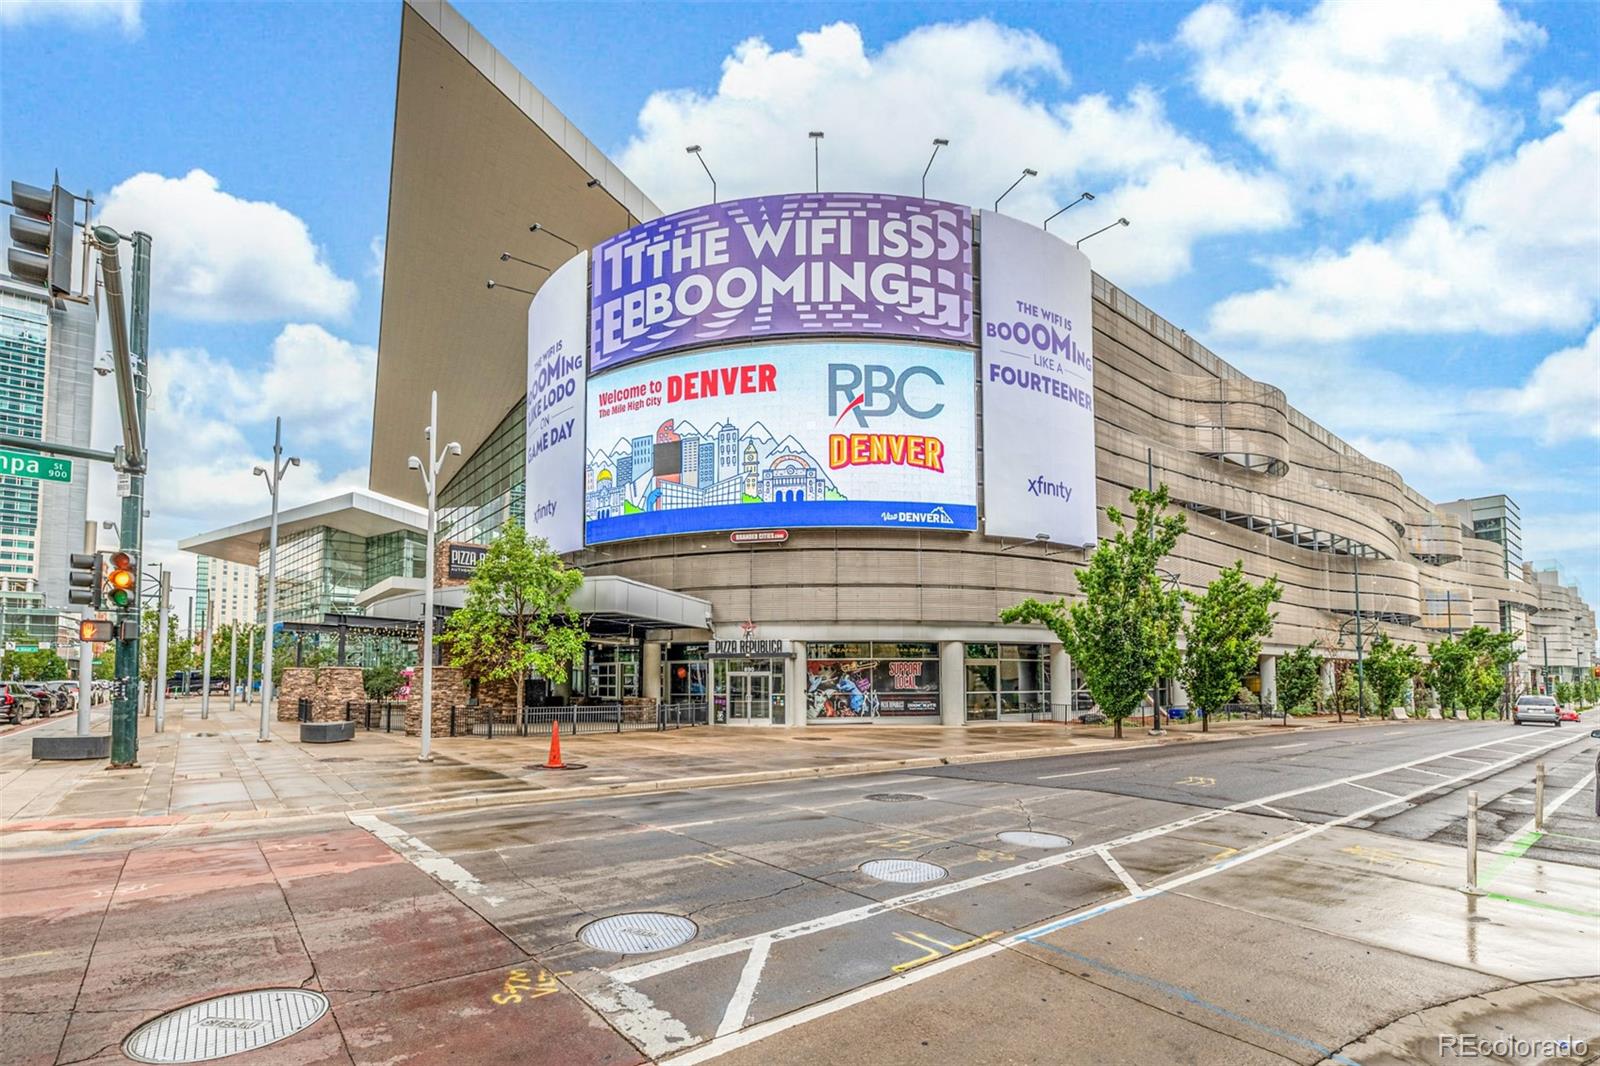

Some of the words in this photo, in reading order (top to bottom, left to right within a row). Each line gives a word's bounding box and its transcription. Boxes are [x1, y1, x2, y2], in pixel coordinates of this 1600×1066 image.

[743, 218, 851, 258] WIFI
[1016, 300, 1039, 318] THE
[1041, 308, 1063, 327] WIFI
[1064, 318, 1072, 331] IS
[556, 339, 562, 352] IS
[986, 321, 1092, 372] BOOOMING
[1034, 353, 1055, 371] LIKE
[1056, 363, 1063, 375] A
[543, 378, 576, 411] LODO
[599, 384, 647, 407] Welcome
[649, 380, 662, 394] to
[667, 363, 777, 403] DENVER
[990, 363, 1092, 411] FOURTEENER
[599, 408, 610, 418] The
[612, 403, 626, 414] Mile
[627, 399, 645, 411] High
[646, 396, 662, 407] City
[828, 363, 945, 428] RBC
[540, 413, 550, 430] ON
[550, 418, 575, 446] DAY
[829, 433, 945, 474] DENVER
[48, 470, 68, 479] 900
[53, 462, 64, 471] St
[1027, 475, 1072, 502] xfinity
[898, 511, 940, 524] DENVER
[451, 549, 477, 566] PIZZA
[715, 640, 738, 653] PIZZA
[740, 640, 783, 654] REPUBLICA
[888, 661, 923, 676] SUPPORT
[894, 675, 918, 689] LOCAL
